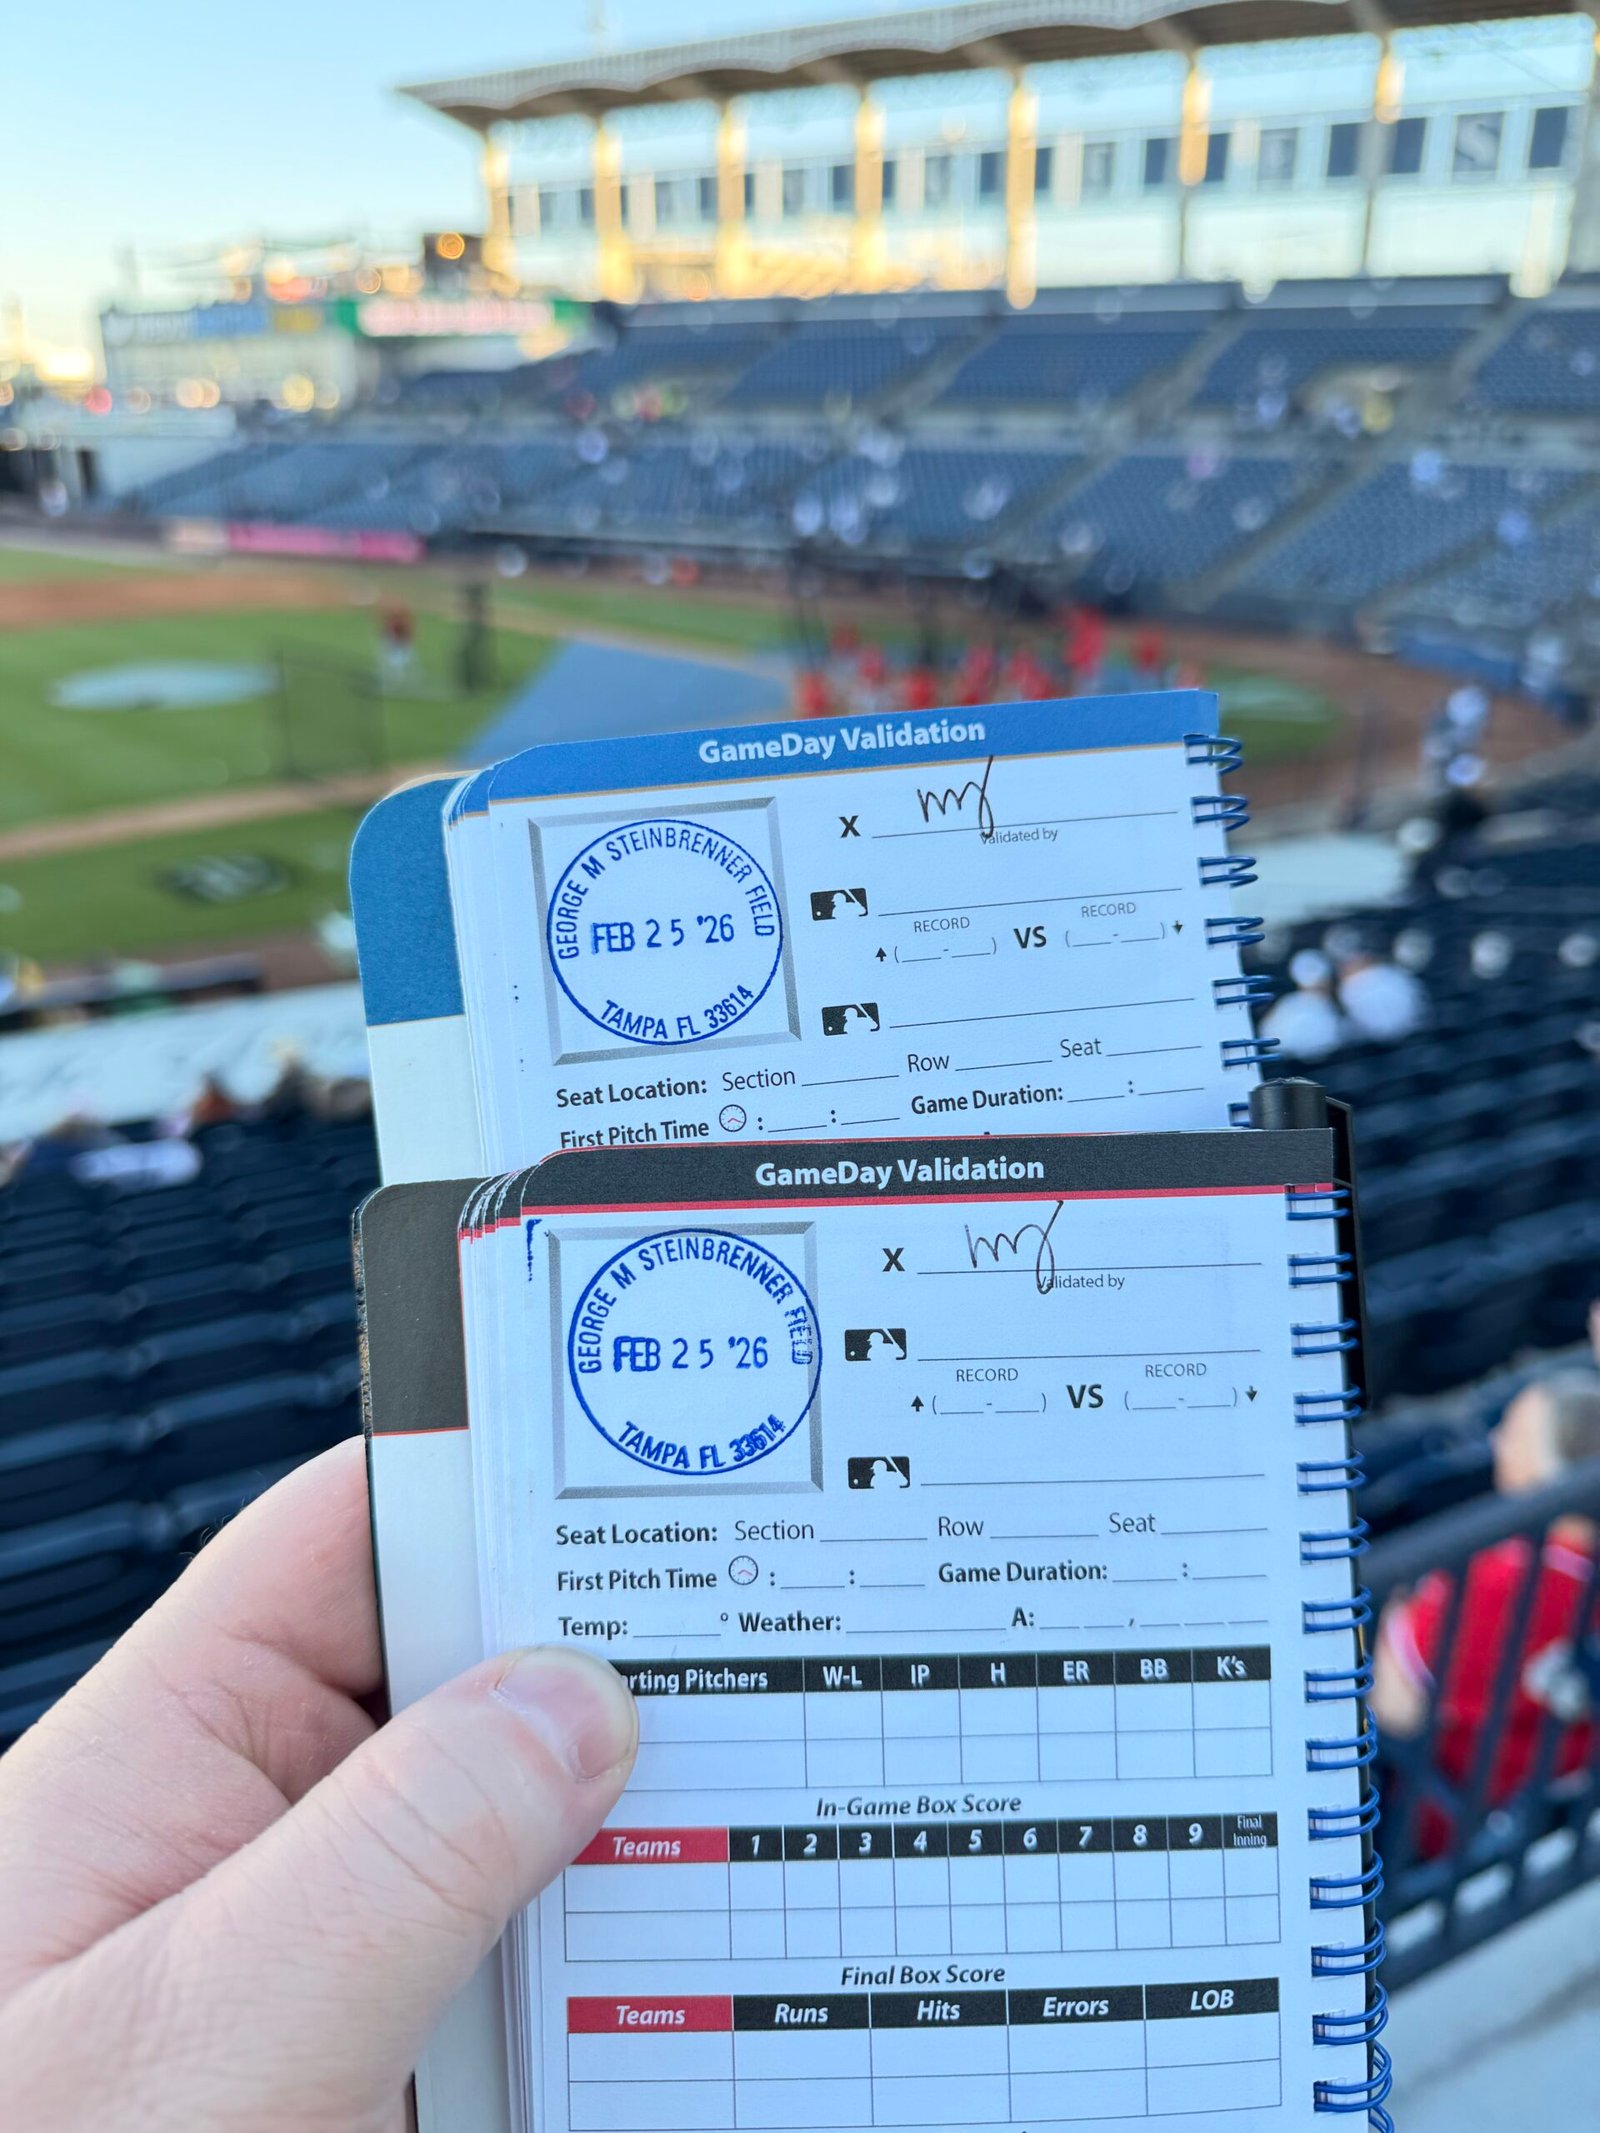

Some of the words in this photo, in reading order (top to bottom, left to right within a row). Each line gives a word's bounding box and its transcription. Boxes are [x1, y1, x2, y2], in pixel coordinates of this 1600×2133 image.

[699, 733, 836, 763] GameDay
[840, 719, 986, 751] Validation
[980, 829, 1039, 846] Validated
[1042, 827, 1059, 844] by
[557, 880, 588, 959] GEORGE
[582, 855, 606, 879] M
[606, 826, 753, 884] STEINBRENNER
[745, 884, 775, 937] FIELD
[1081, 902, 1137, 918] RECORD
[914, 917, 971, 933] RECORD
[591, 922, 635, 954] FEB
[1013, 926, 1047, 950] VS
[599, 1000, 669, 1039] TAMPA
[677, 1016, 700, 1037] FL
[704, 984, 755, 1028] 33614
[556, 1087, 604, 1108] Seat
[608, 1078, 708, 1103] Location:
[721, 1068, 796, 1092] Section
[907, 1053, 950, 1073] Row
[1060, 1038, 1102, 1058] Seat
[560, 1128, 605, 1149] First
[608, 1122, 657, 1145] Pitch
[660, 1119, 710, 1143] Time
[911, 1095, 968, 1116] Game
[974, 1086, 1064, 1110] Duration:
[755, 1161, 892, 1191] GameDay
[898, 1157, 1045, 1182] Validation
[1038, 1274, 1103, 1290] Validated
[1107, 1274, 1125, 1291] by
[578, 1286, 616, 1374] GEORGE
[616, 1267, 637, 1290] M
[638, 1238, 794, 1306] STEINBRENNER
[785, 1306, 813, 1366] FIELD
[613, 1336, 661, 1372] FEB
[956, 1367, 1019, 1383] RECORD
[1145, 1362, 1208, 1379] RECORD
[1067, 1383, 1104, 1409] VS
[619, 1421, 691, 1469] TAMPA
[700, 1445, 726, 1468] FL
[731, 1414, 786, 1462] 33614
[556, 1524, 607, 1546] Seat
[612, 1521, 718, 1544] Location:
[735, 1520, 815, 1541] Section
[938, 1516, 984, 1537] Row
[1108, 1513, 1157, 1534] Seat
[557, 1571, 604, 1591] First
[607, 1569, 659, 1591] Pitch
[663, 1568, 718, 1589] Time
[938, 1562, 1002, 1584] Game
[1006, 1561, 1108, 1583] Duration:
[558, 1616, 629, 1640] Temp:
[739, 1612, 841, 1634] Weather:
[1011, 1608, 1035, 1629] A:
[823, 1665, 862, 1687] W-L
[911, 1664, 930, 1685] IP
[991, 1663, 1006, 1683] H
[1063, 1661, 1090, 1682] ER
[1140, 1658, 1168, 1681] BB
[1217, 1655, 1246, 1677] K's
[685, 1667, 768, 1691] Pitchers
[817, 1796, 911, 1818] In-Game
[917, 1795, 957, 1815] Box
[962, 1794, 1021, 1813] Score
[1236, 1814, 1263, 1830] Final
[751, 1834, 761, 1856] 1
[803, 1833, 818, 1855] 2
[858, 1832, 872, 1854] 3
[913, 1830, 928, 1852] 4
[968, 1829, 983, 1852] 5
[1023, 1827, 1038, 1850] 6
[1079, 1826, 1093, 1848] 7
[1133, 1825, 1148, 1846] 8
[1187, 1823, 1203, 1846] 9
[1233, 1831, 1268, 1848] Inning
[613, 1836, 682, 1858] Teams
[841, 1965, 895, 1986] Final
[900, 1965, 941, 1984] Box
[946, 1965, 1006, 1983] Score
[917, 1999, 961, 2021] Hits
[1043, 1996, 1110, 2018] Errors
[1191, 1989, 1234, 2011] LOB
[616, 2004, 686, 2026] Teams
[774, 2003, 829, 2025] Runs
